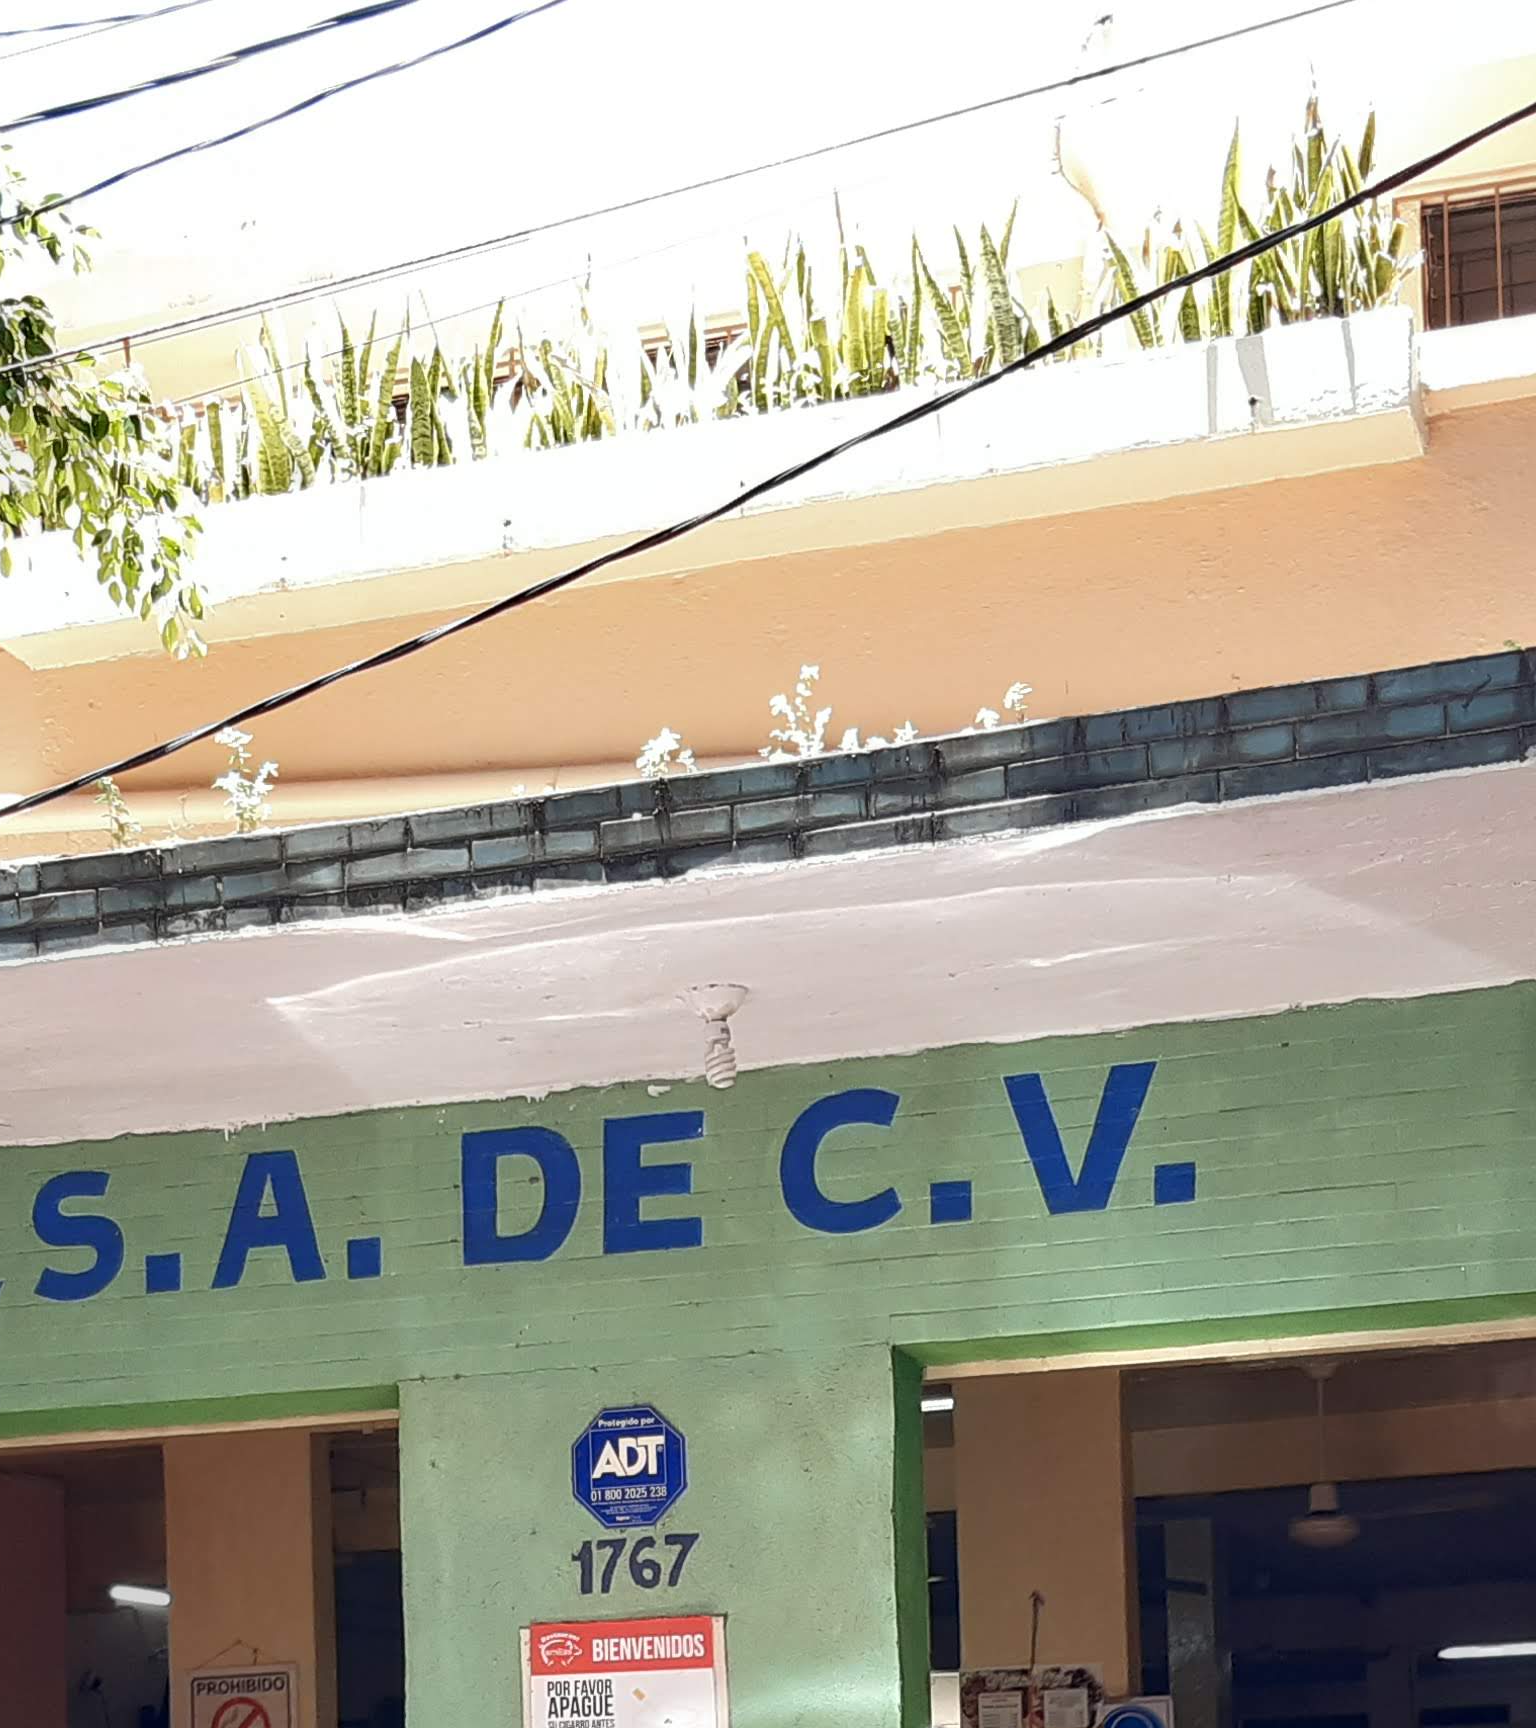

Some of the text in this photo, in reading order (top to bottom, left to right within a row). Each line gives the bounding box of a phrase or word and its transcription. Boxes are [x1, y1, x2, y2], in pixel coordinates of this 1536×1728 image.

[32, 1149, 382, 1302] S.A.
[460, 1110, 706, 1267] DE
[778, 1061, 1197, 1235] C.V.
[598, 1417, 655, 1428] Protegido por
[592, 1435, 665, 1479] ADT
[591, 1486, 667, 1501] 01 800 2025 238
[571, 1532, 700, 1595] 1767
[592, 1634, 705, 1663] BIENVENIDOS
[196, 1676, 285, 1696] PROHIBIDO
[547, 1679, 612, 1697] POR FAVOR
[548, 1695, 614, 1719] APAGUE
[591, 1719, 615, 1728] ANTES
